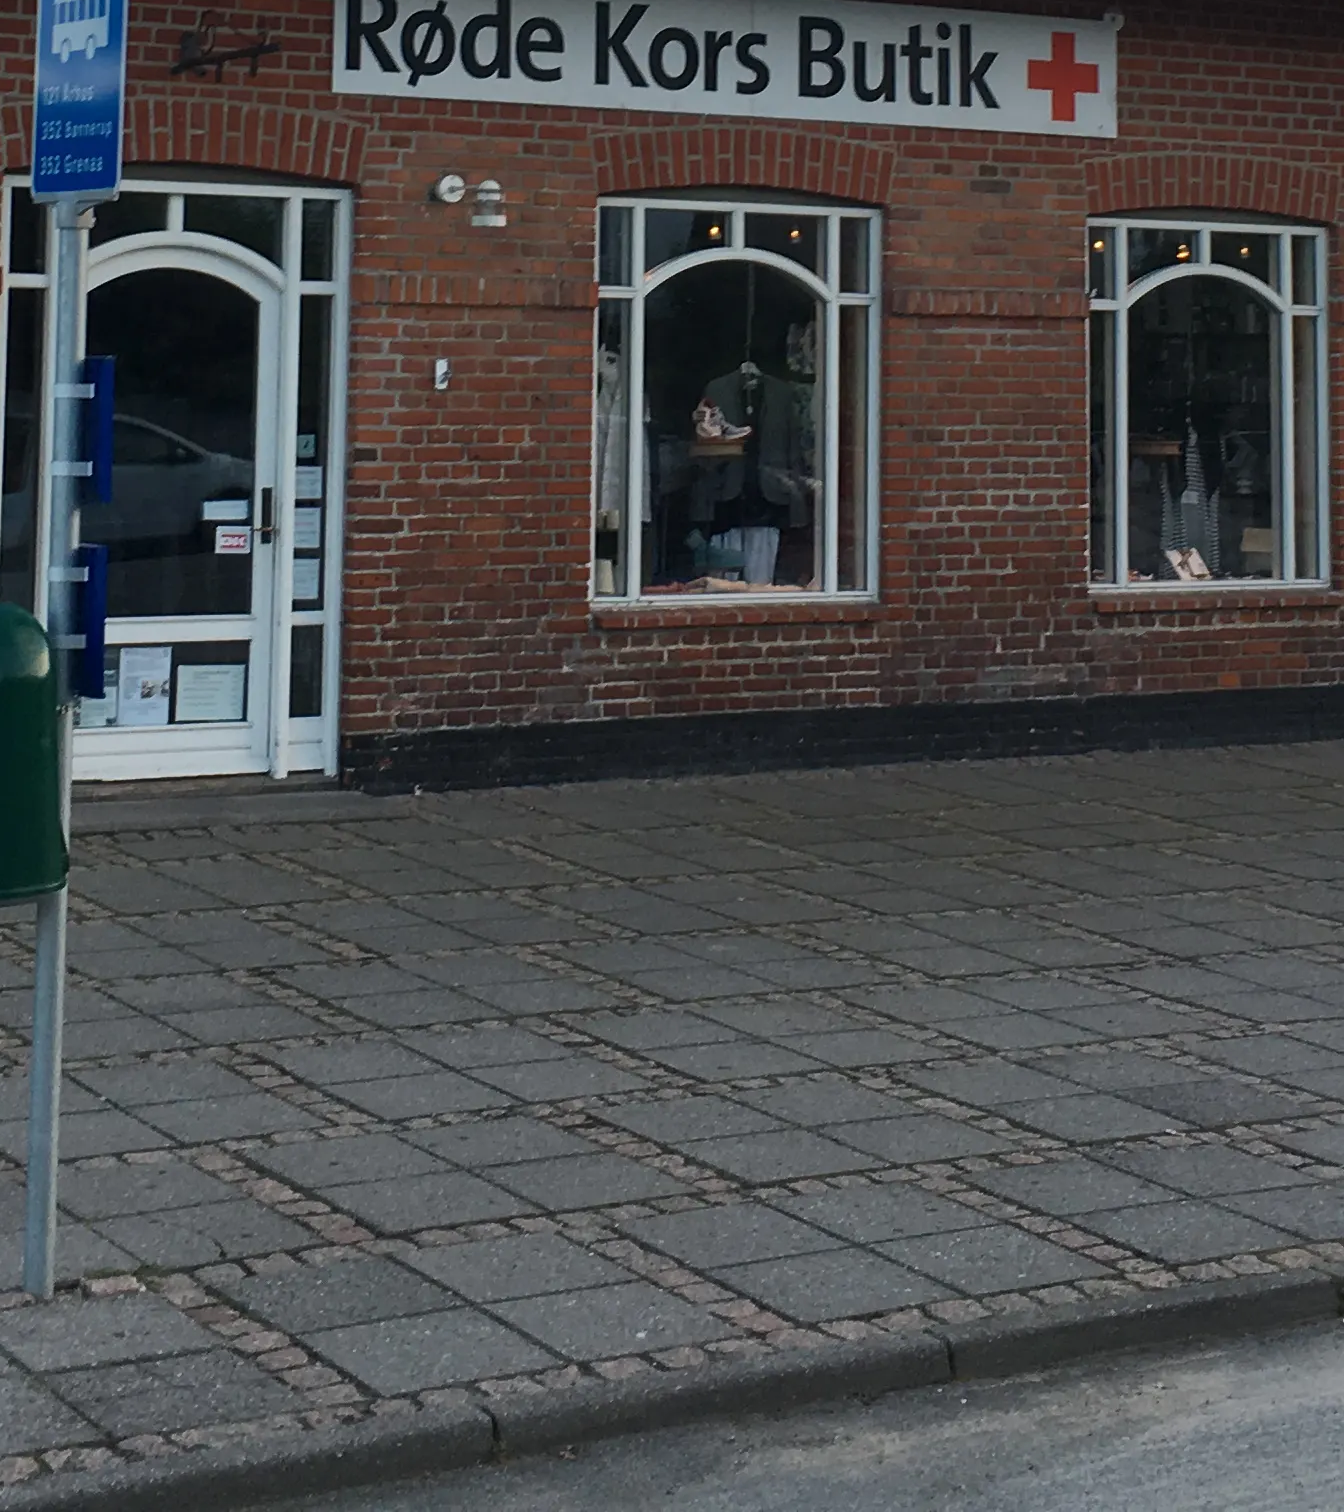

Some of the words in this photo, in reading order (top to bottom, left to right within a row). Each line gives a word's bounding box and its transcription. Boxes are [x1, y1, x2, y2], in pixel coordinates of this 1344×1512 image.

[594, 0, 771, 94] Kors
[797, 15, 1002, 110] Butik
[41, 120, 62, 140] 352
[39, 154, 61, 175] 352
